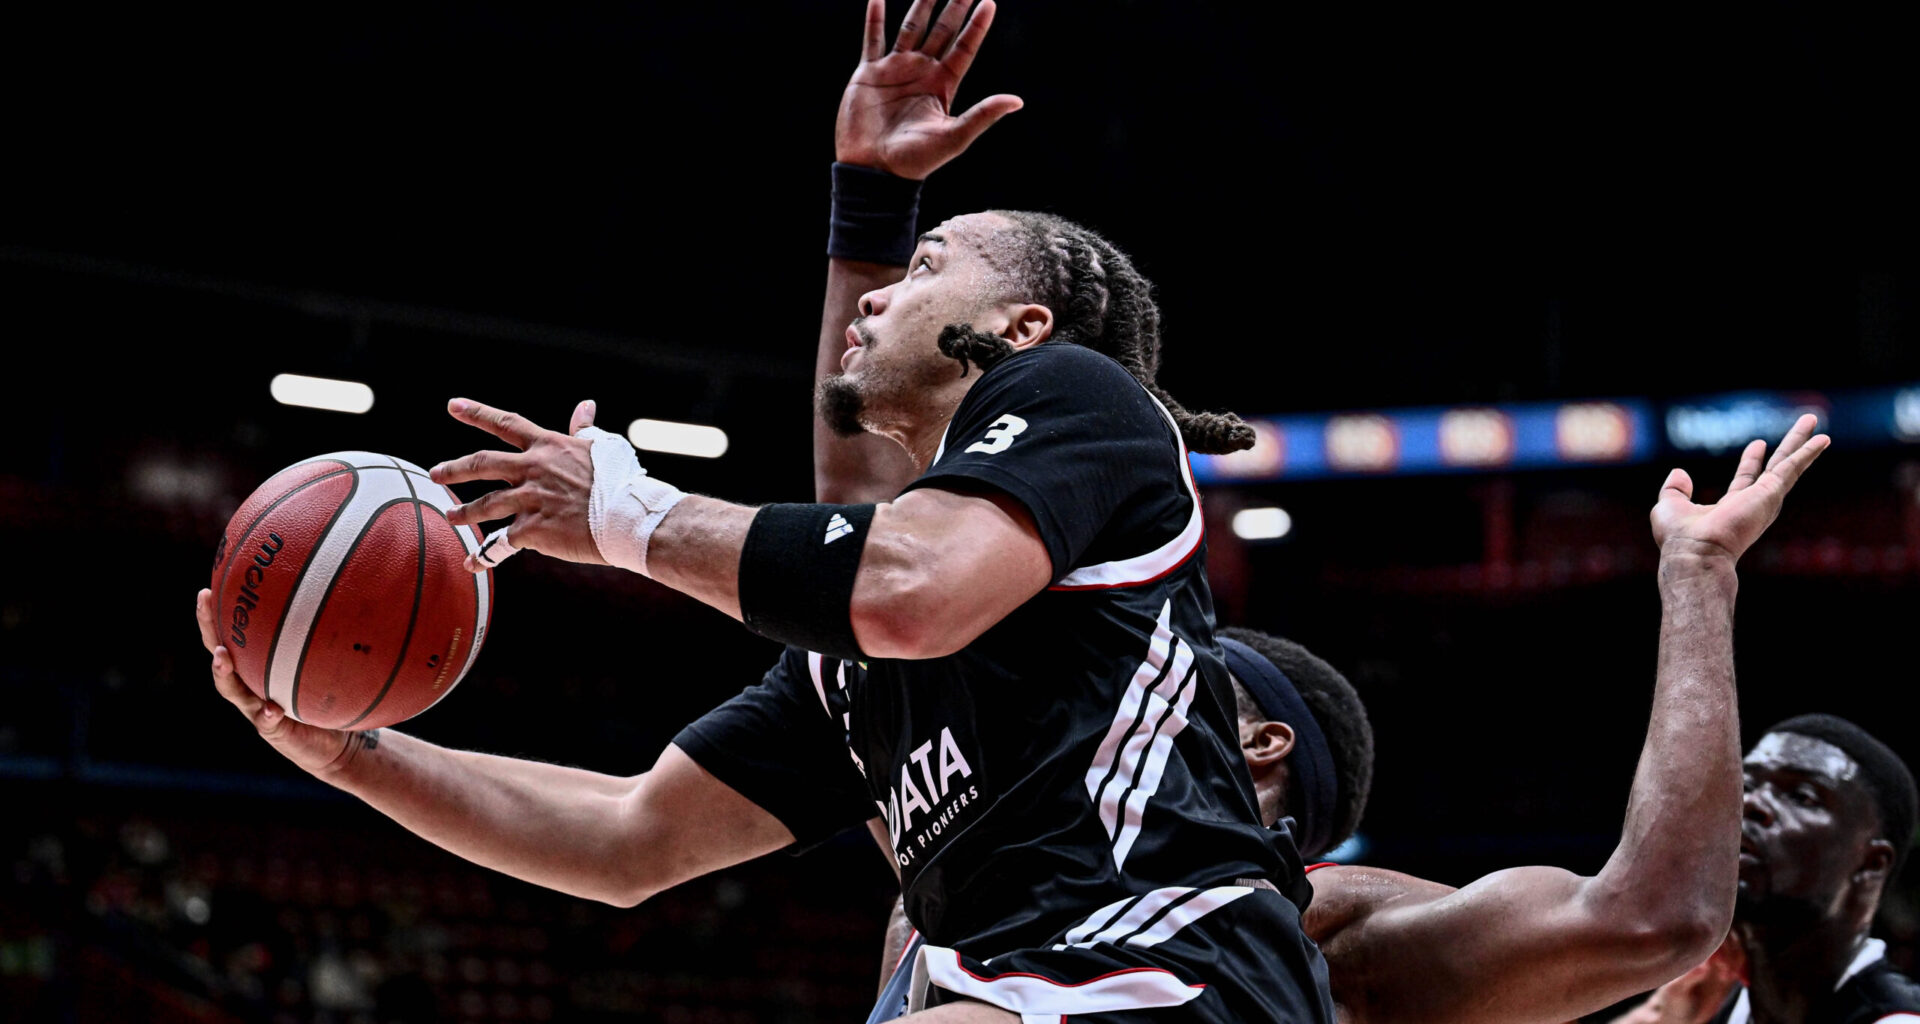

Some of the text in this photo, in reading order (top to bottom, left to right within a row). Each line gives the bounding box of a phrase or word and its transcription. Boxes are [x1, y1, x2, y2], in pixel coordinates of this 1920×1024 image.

[964, 413, 1029, 455] 3
[231, 531, 284, 648] molten
[899, 785, 979, 866] OF PIONEERS
